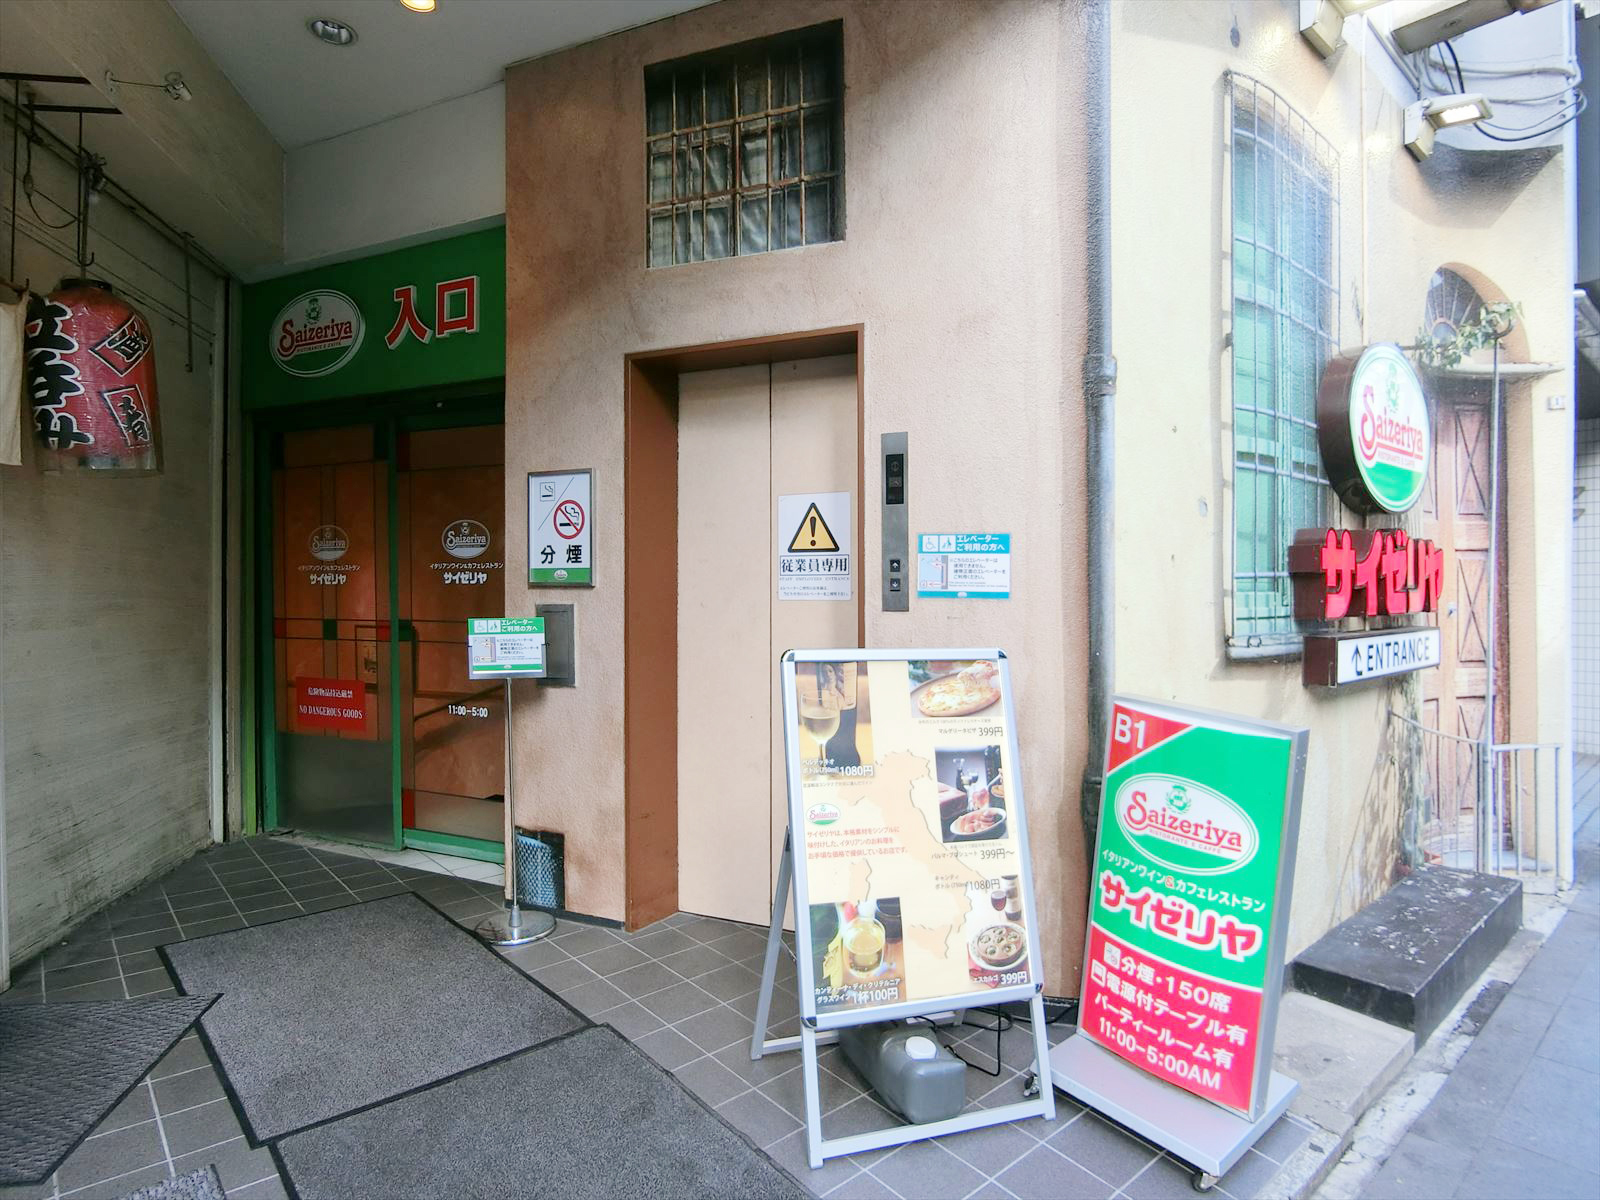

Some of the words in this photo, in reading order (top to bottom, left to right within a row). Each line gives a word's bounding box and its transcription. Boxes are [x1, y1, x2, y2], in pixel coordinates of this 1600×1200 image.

[385, 275, 480, 350] 入口
[279, 318, 353, 356] Saizeriya
[1361, 384, 1424, 455] Saizeriya
[312, 535, 346, 550] Saizeriya
[446, 531, 487, 549] Saizeriya
[957, 535, 999, 543] エレベーター
[957, 543, 1005, 552] ご利用の方へ
[540, 544, 583, 565] 分煙
[781, 558, 848, 573] 従業員専用
[1321, 527, 1444, 621] サイゼリヤ
[309, 573, 347, 585] サイゼリヤ
[443, 572, 488, 585] サイゼリヤ
[1366, 636, 1430, 672] ENTRANCE
[299, 704, 308, 714] NO
[308, 705, 342, 718] DANGEROUS
[342, 708, 363, 720] GOODS
[978, 726, 1004, 737] 399円
[1114, 712, 1147, 749] B1
[839, 765, 874, 777] 1080円
[1124, 790, 1243, 849] Saizeriya
[969, 878, 1001, 891] 1080円
[1100, 871, 1262, 961] サイゼリヤ
[1000, 970, 1027, 985] 399円
[1106, 971, 1249, 1047] 電源付テーブル有
[1095, 992, 1235, 1070] パーティールーム有
